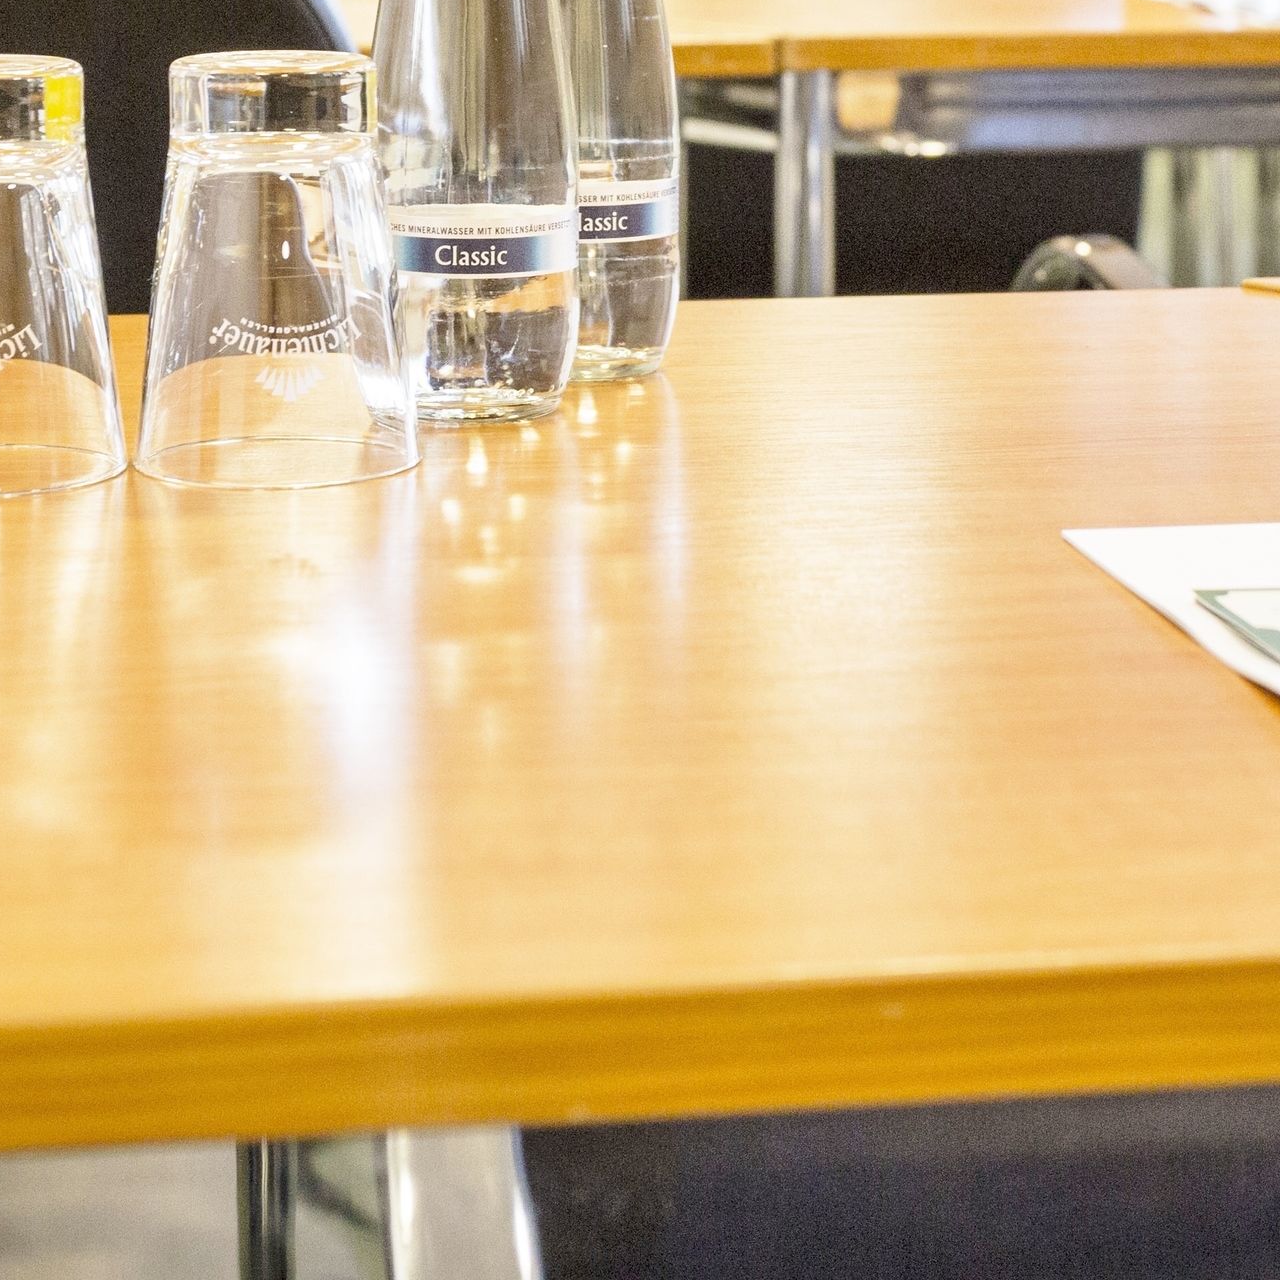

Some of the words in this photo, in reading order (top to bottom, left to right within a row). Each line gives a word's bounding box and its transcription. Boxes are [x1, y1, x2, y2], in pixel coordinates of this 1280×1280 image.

[408, 224, 474, 235] MINERALWASSER
[477, 226, 493, 235] MIT
[495, 222, 547, 235] KOHLENSÄURE
[434, 244, 508, 267] Classic
